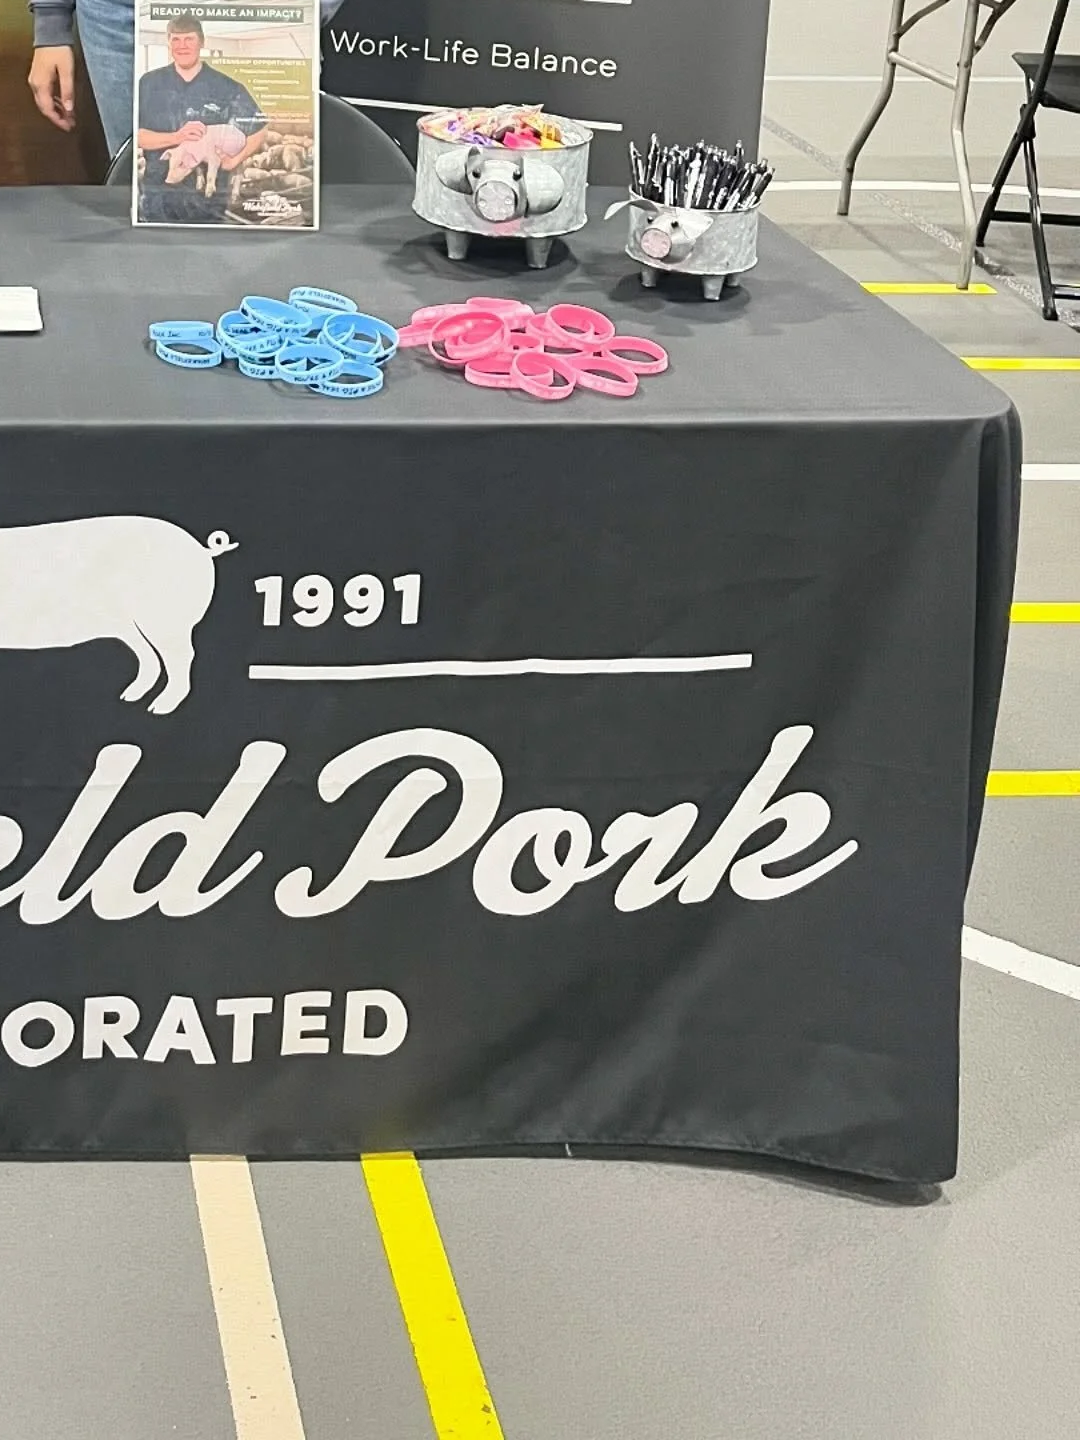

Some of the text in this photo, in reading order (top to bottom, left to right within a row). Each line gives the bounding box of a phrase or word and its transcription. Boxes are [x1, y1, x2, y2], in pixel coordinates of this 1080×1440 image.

[153, 7, 302, 19] READY TO MAKE AN IMPACT?
[329, 29, 618, 78] Work-Life Balance
[253, 573, 423, 628] 1991
[273, 724, 860, 918] Pork
